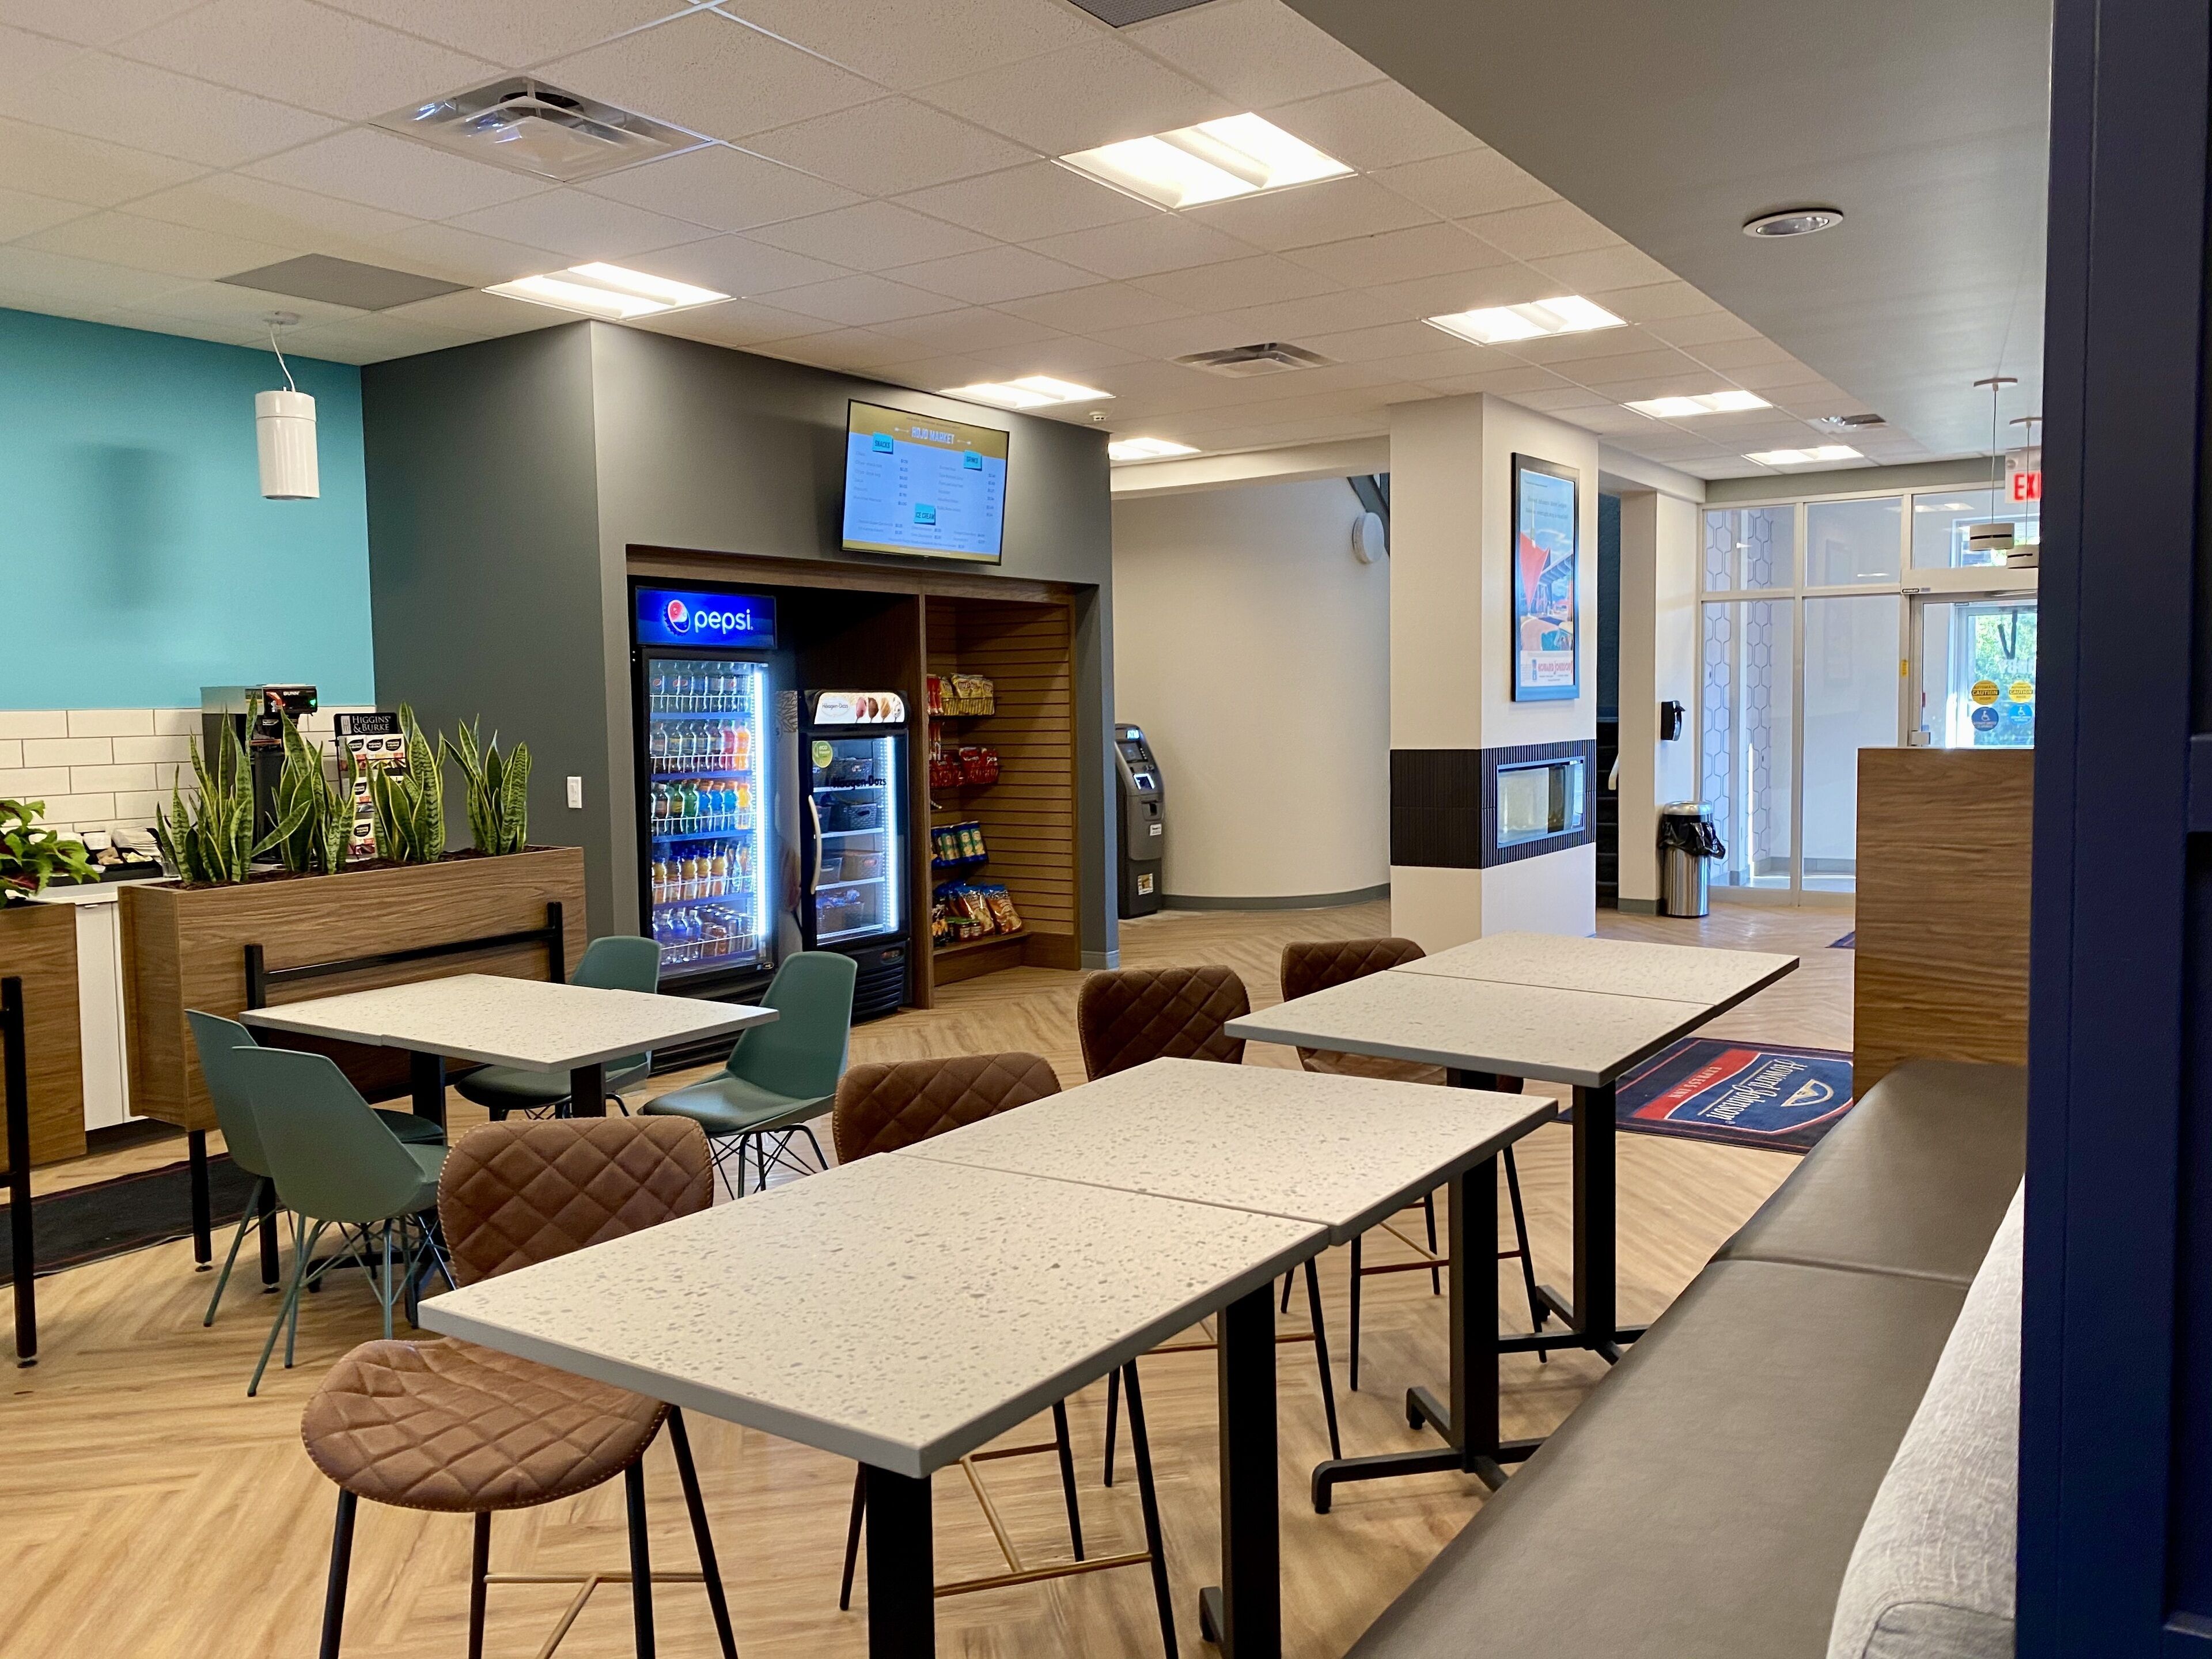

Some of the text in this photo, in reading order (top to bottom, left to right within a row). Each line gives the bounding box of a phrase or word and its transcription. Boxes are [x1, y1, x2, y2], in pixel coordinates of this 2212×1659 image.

[912, 427, 955, 444] HOJO MARKET
[2014, 473, 2041, 501] EXI
[694, 608, 751, 635] pepsi
[353, 715, 389, 724] HIGGINS
[353, 724, 390, 733] & BURKE
[1668, 1066, 1722, 1098] EXPRESS INN
[1706, 1059, 1808, 1120] Howard Johnson
